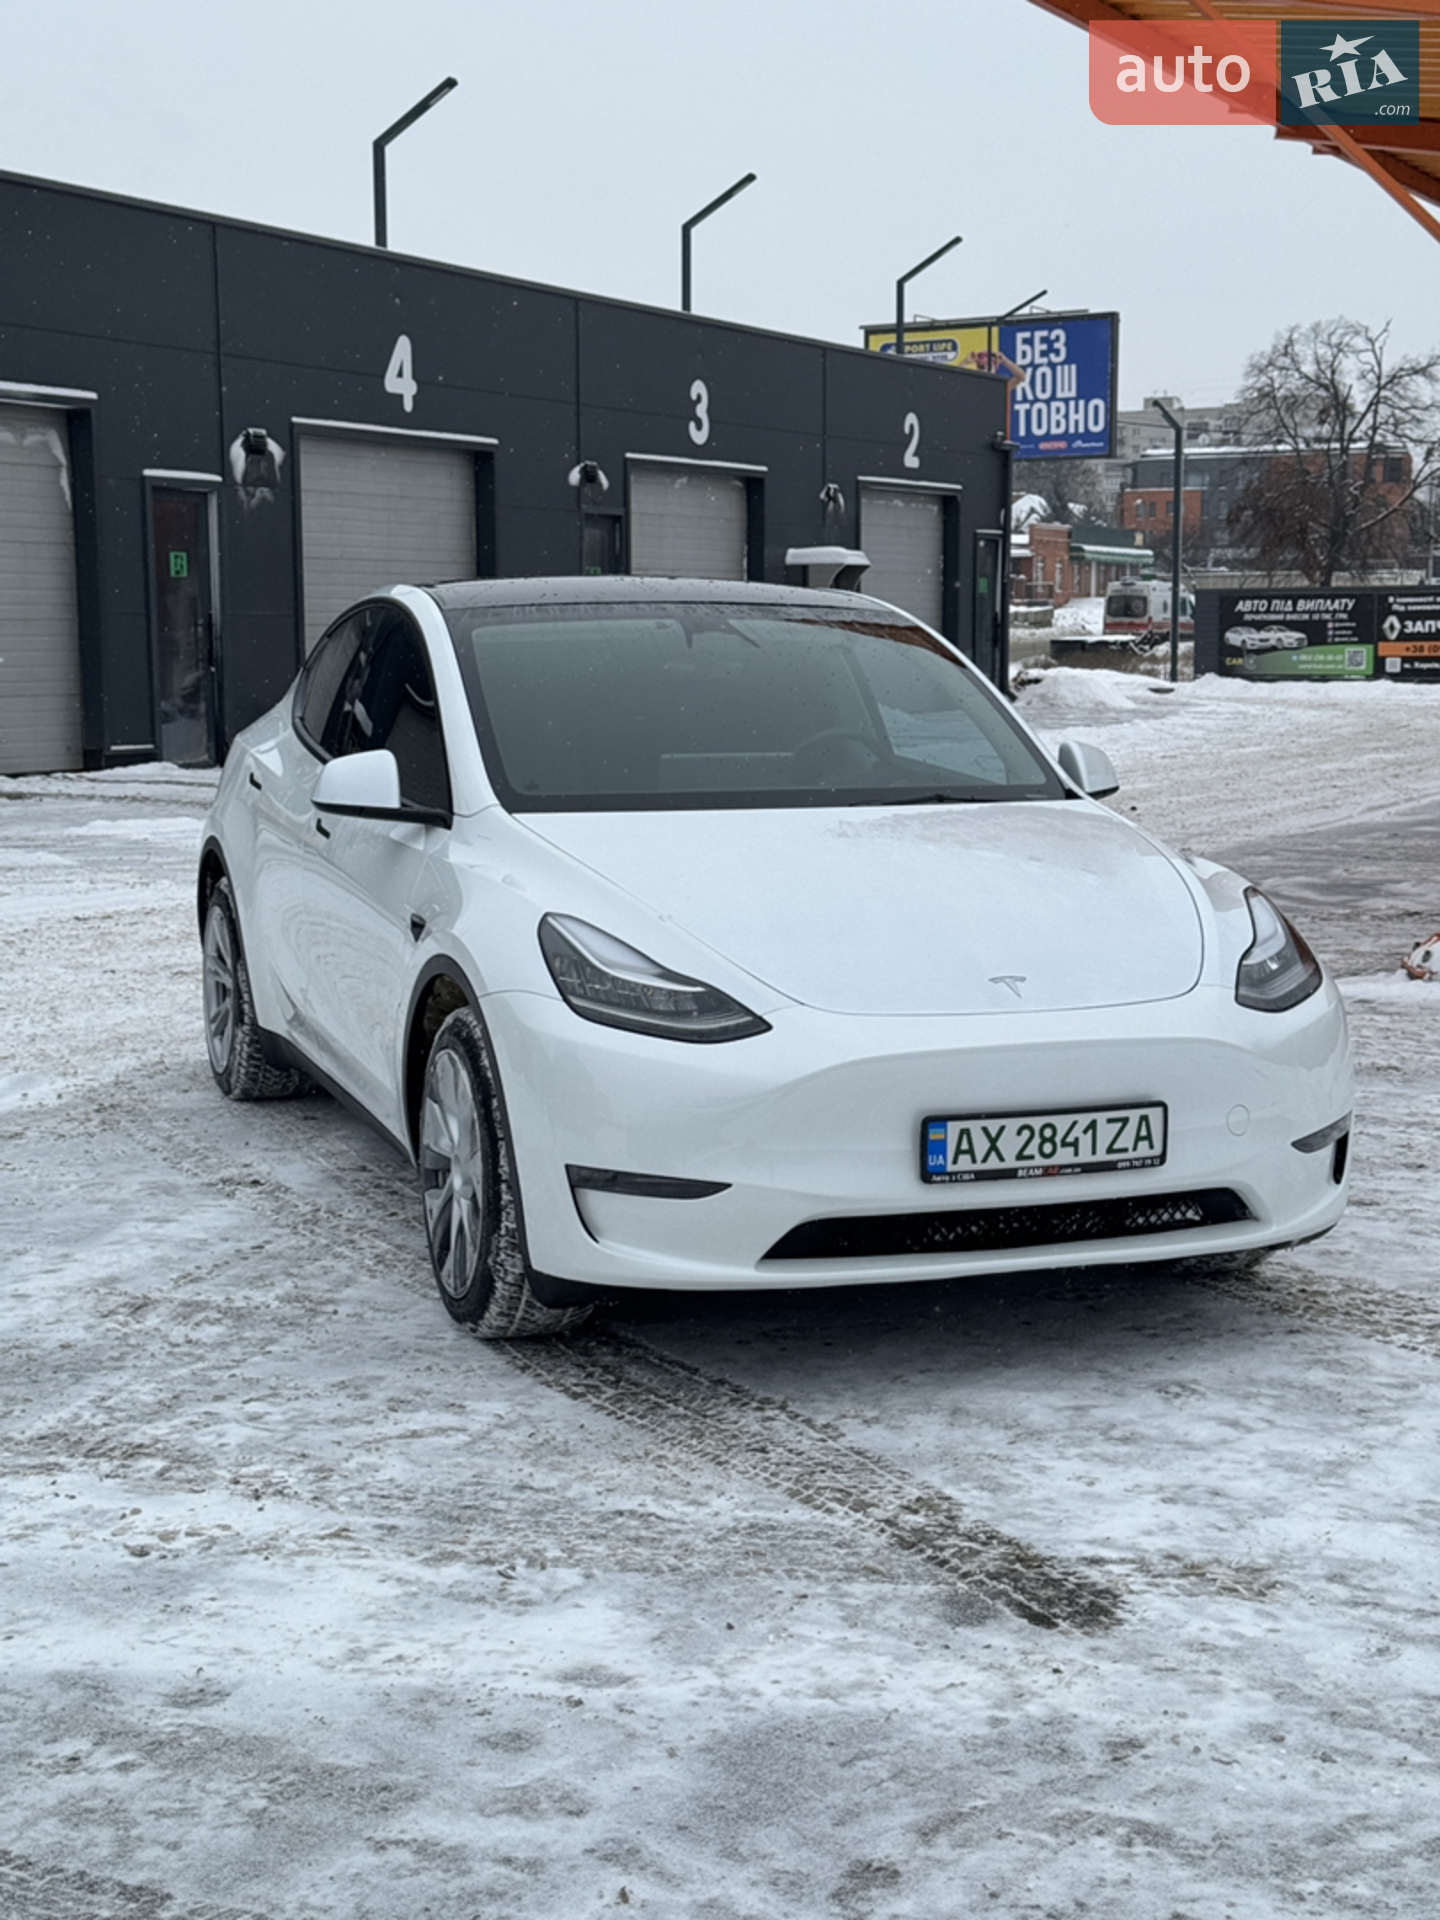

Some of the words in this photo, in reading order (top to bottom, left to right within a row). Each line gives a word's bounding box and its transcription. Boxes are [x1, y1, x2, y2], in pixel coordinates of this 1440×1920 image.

[903, 342, 931, 353] PORT
[1016, 329, 1066, 366] БЕЗ
[384, 334, 418, 413] 4
[1016, 364, 1077, 401] КОШ
[688, 379, 710, 446] 3
[1014, 398, 1106, 437] ТОВНО
[903, 411, 920, 469] 2
[1234, 600, 1269, 612] АВТО
[1270, 600, 1293, 612] ПІД
[1296, 598, 1356, 612] ВИПЛАТУ
[951, 1125, 1007, 1165] AX
[1015, 1119, 1098, 1162] 2841
[1105, 1114, 1155, 1155] ZA
[929, 1154, 945, 1166] UA
